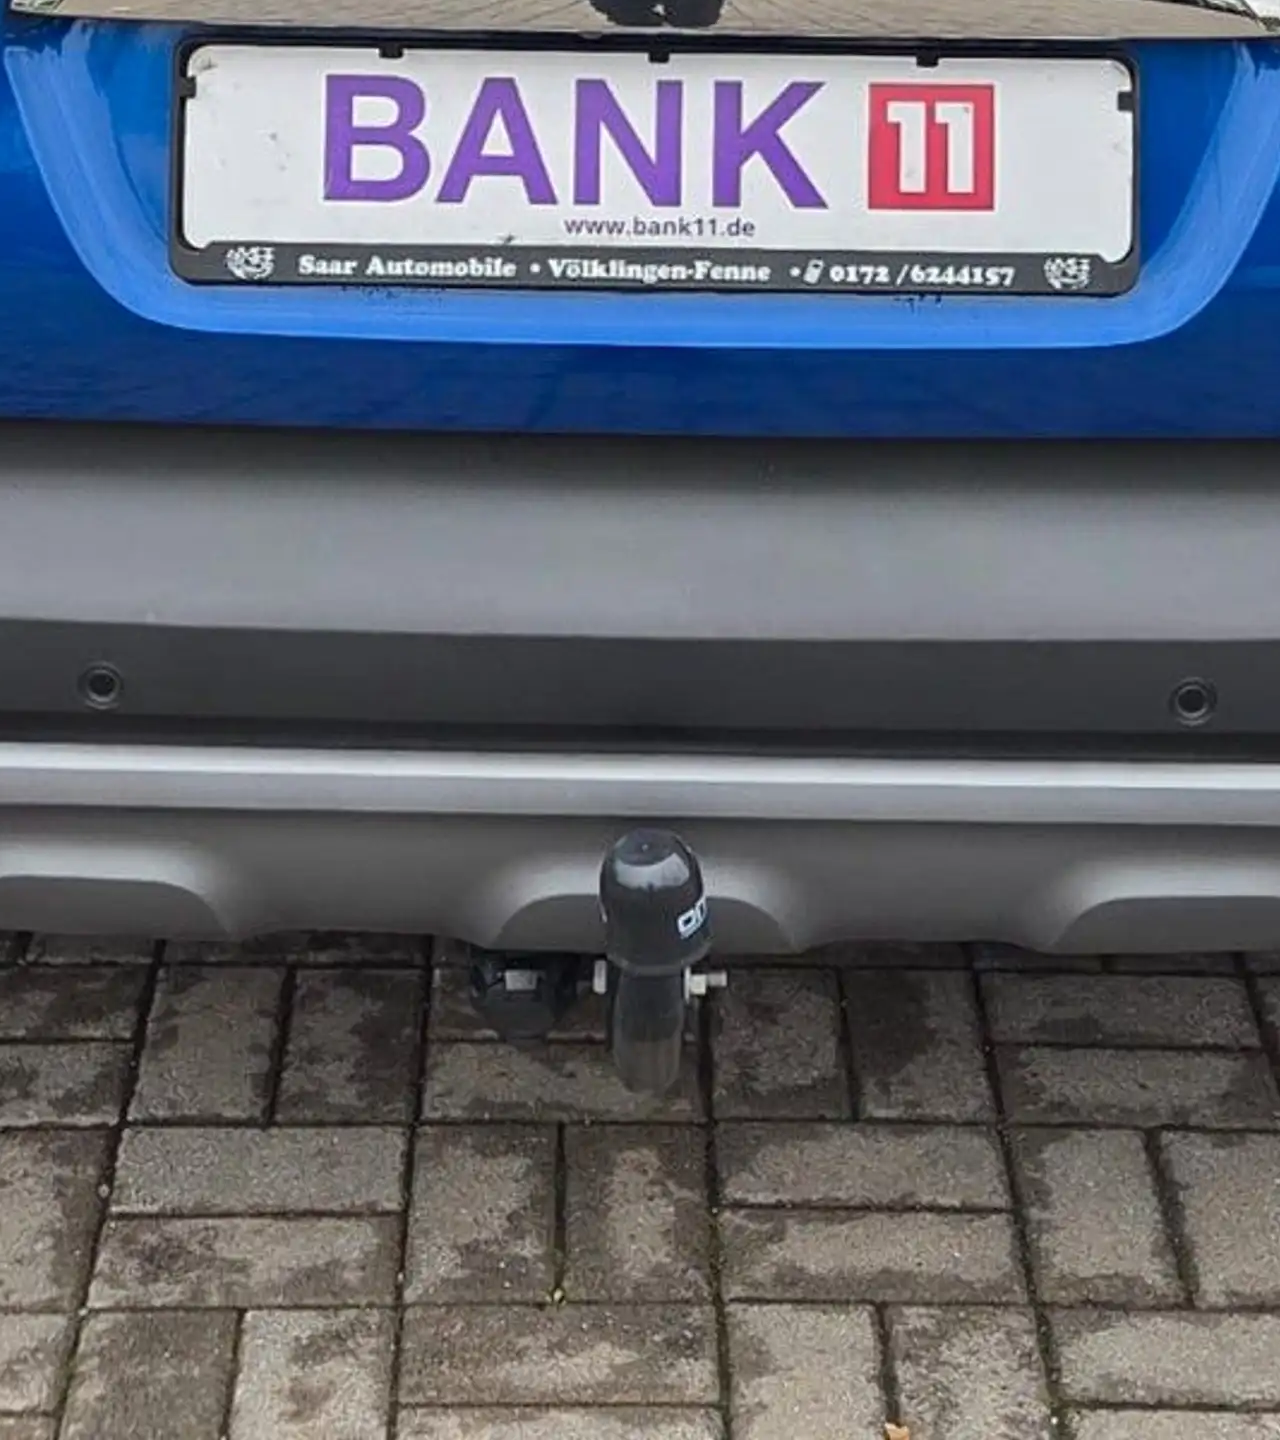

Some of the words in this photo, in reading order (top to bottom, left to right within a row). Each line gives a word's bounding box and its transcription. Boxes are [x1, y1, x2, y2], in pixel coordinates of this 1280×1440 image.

[323, 73, 829, 209] BANK
[882, 97, 980, 200] 11
[564, 216, 757, 238] www.bank11.de
[298, 255, 357, 276] Saar
[365, 255, 518, 278] Automobile
[547, 257, 772, 285] Völklingen-Fenne
[829, 265, 891, 285] 0172
